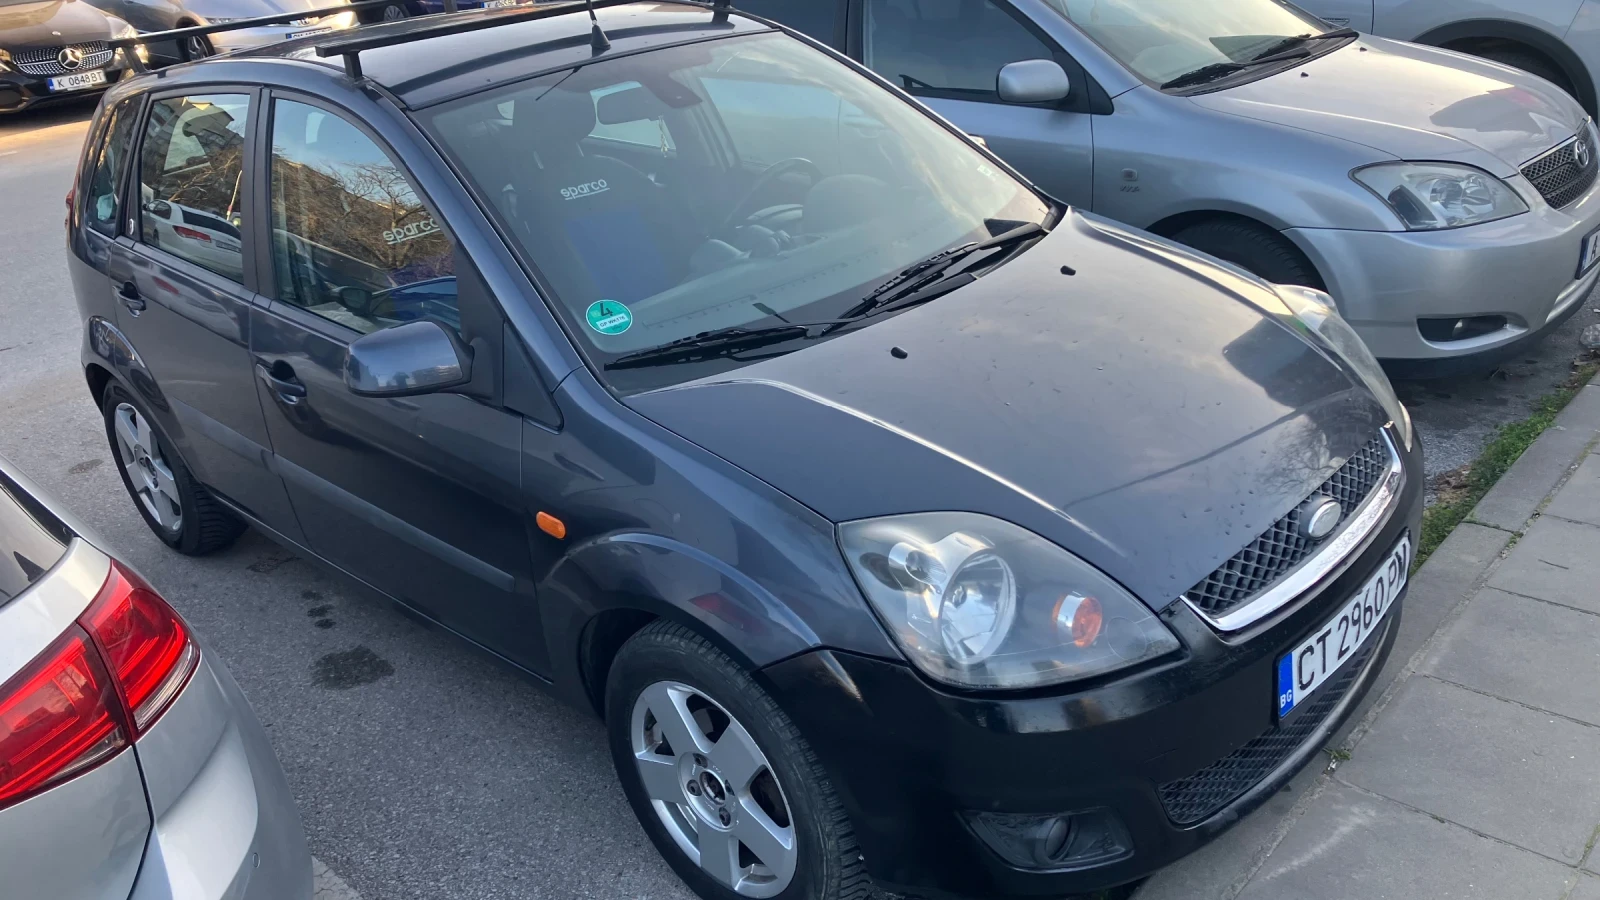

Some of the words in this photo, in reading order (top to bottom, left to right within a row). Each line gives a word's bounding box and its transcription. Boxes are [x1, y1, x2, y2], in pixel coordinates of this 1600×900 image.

[57, 79, 64, 88] K
[560, 178, 608, 199] sparco
[600, 302, 613, 317] 4
[1298, 627, 1331, 691] CT
[1280, 689, 1293, 709] BG
